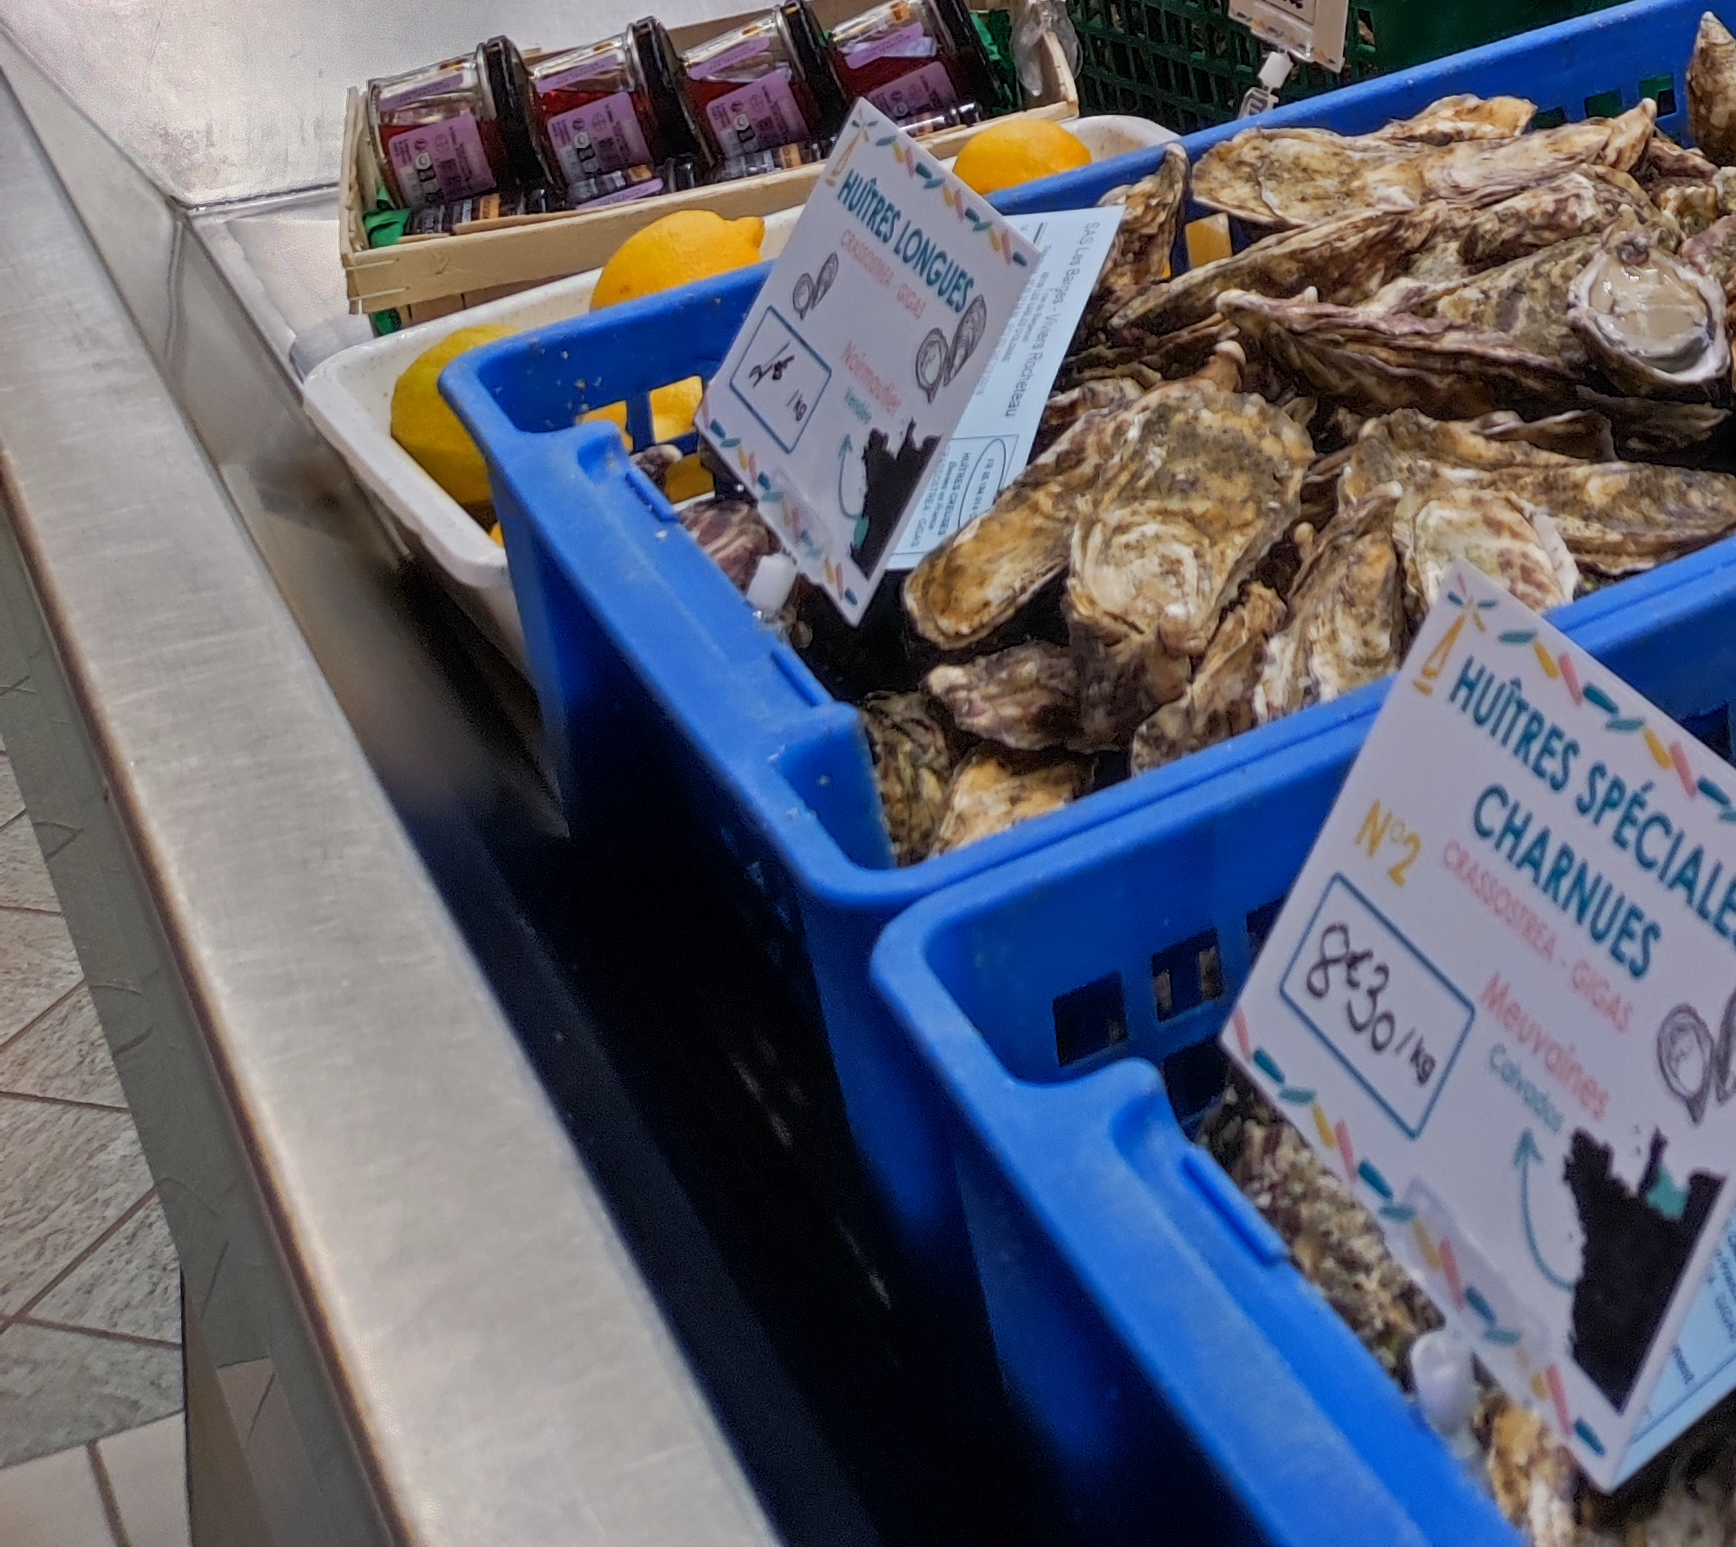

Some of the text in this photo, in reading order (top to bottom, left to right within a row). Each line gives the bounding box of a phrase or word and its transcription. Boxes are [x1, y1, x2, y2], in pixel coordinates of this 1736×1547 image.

[837, 168, 974, 313] HUÎTRES LONGUES
[1069, 246, 1088, 269] Les
[1078, 218, 1101, 249] SAS
[1049, 264, 1080, 308] Barges
[1032, 309, 1061, 353] Viviers
[1003, 350, 1043, 421] Rocheteau
[1450, 654, 1580, 792] HUÎTRES
[1473, 783, 1662, 979] CHARNUES
[1571, 959, 1634, 1035] GIGAS
[1480, 970, 1612, 1122] Meuvaines
